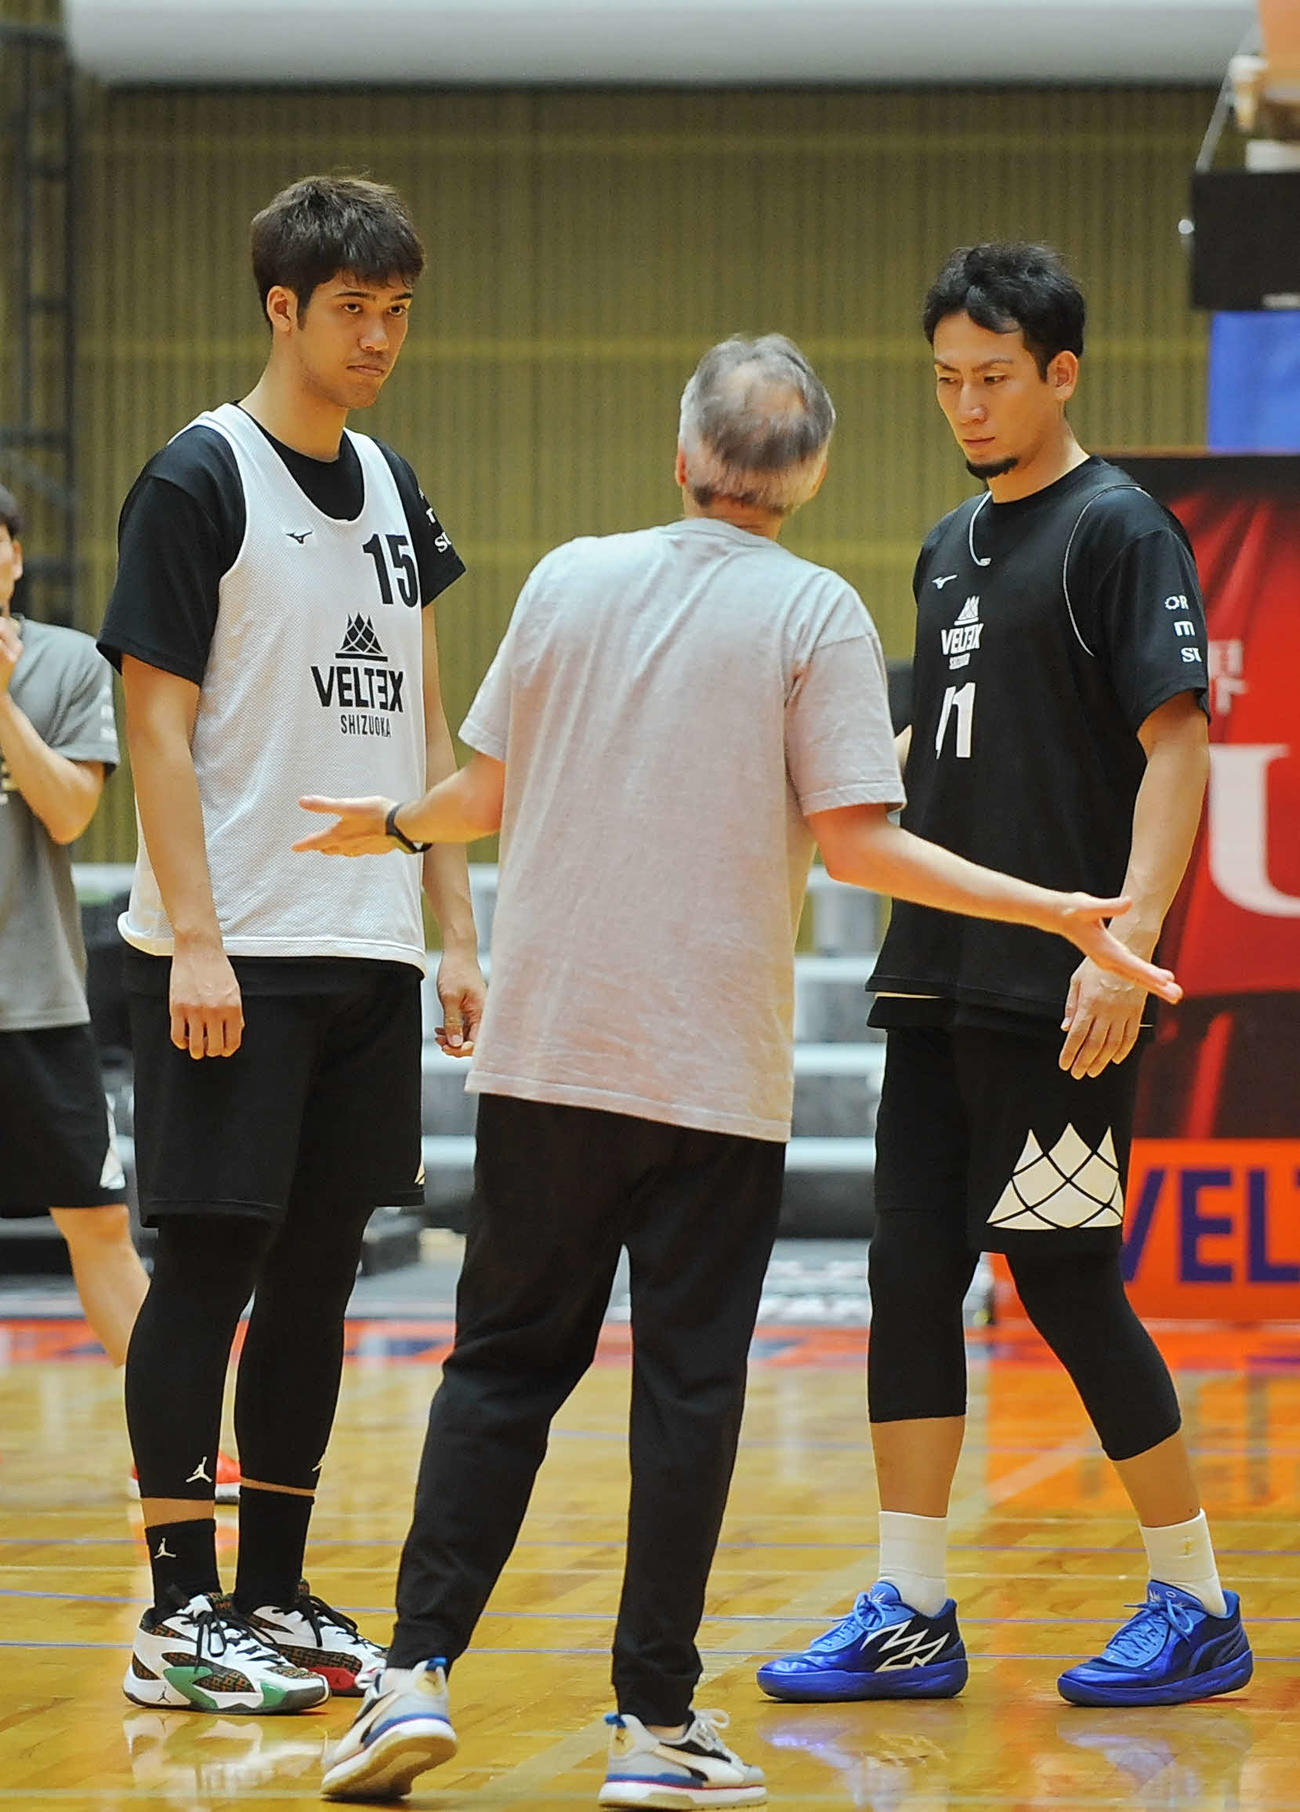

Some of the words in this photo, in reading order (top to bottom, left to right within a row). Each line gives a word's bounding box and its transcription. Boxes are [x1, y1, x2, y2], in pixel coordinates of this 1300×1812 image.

[362, 533, 419, 608] 15
[310, 665, 404, 713] VELTEX
[340, 714, 392, 738] SHIZUOKA
[1119, 1166, 1300, 1284] VEL
